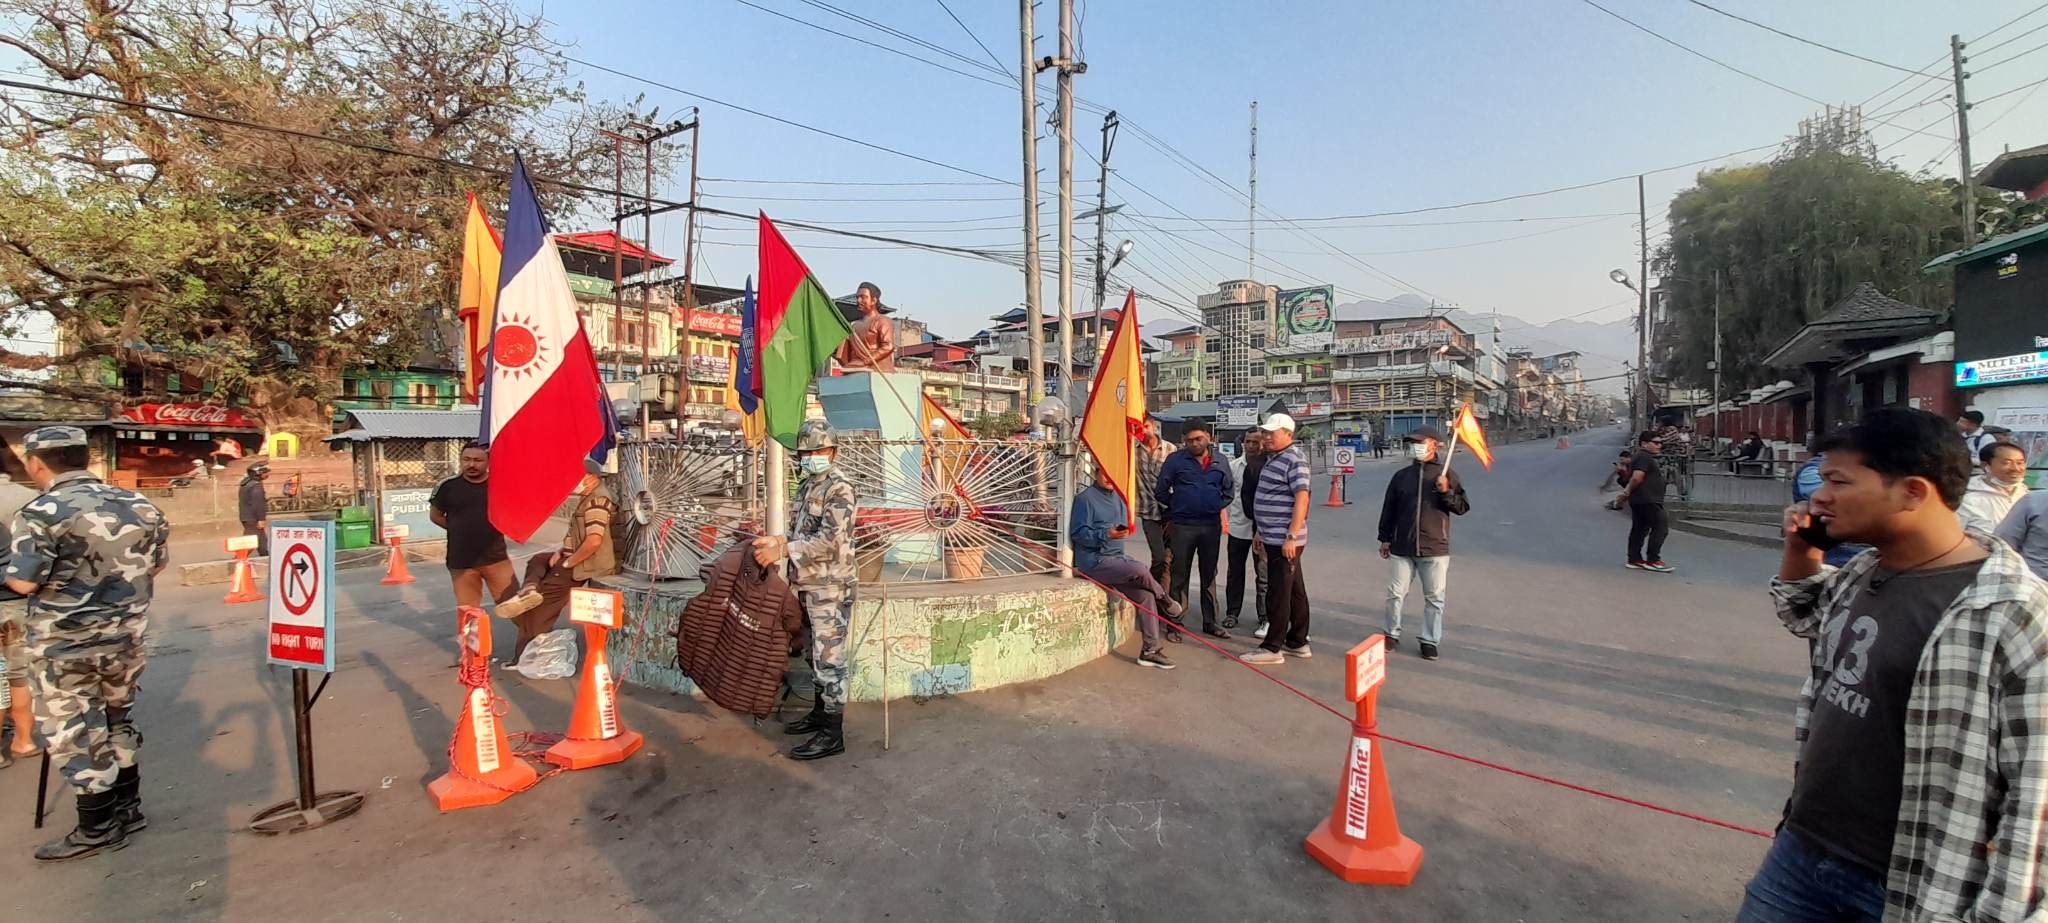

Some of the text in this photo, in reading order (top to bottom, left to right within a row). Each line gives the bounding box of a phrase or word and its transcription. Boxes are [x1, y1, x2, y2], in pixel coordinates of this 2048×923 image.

[1978, 354, 2036, 369] MITERI
[272, 632, 324, 651] NO RIGHT TURN
[1348, 747, 1369, 831] Hilltake
